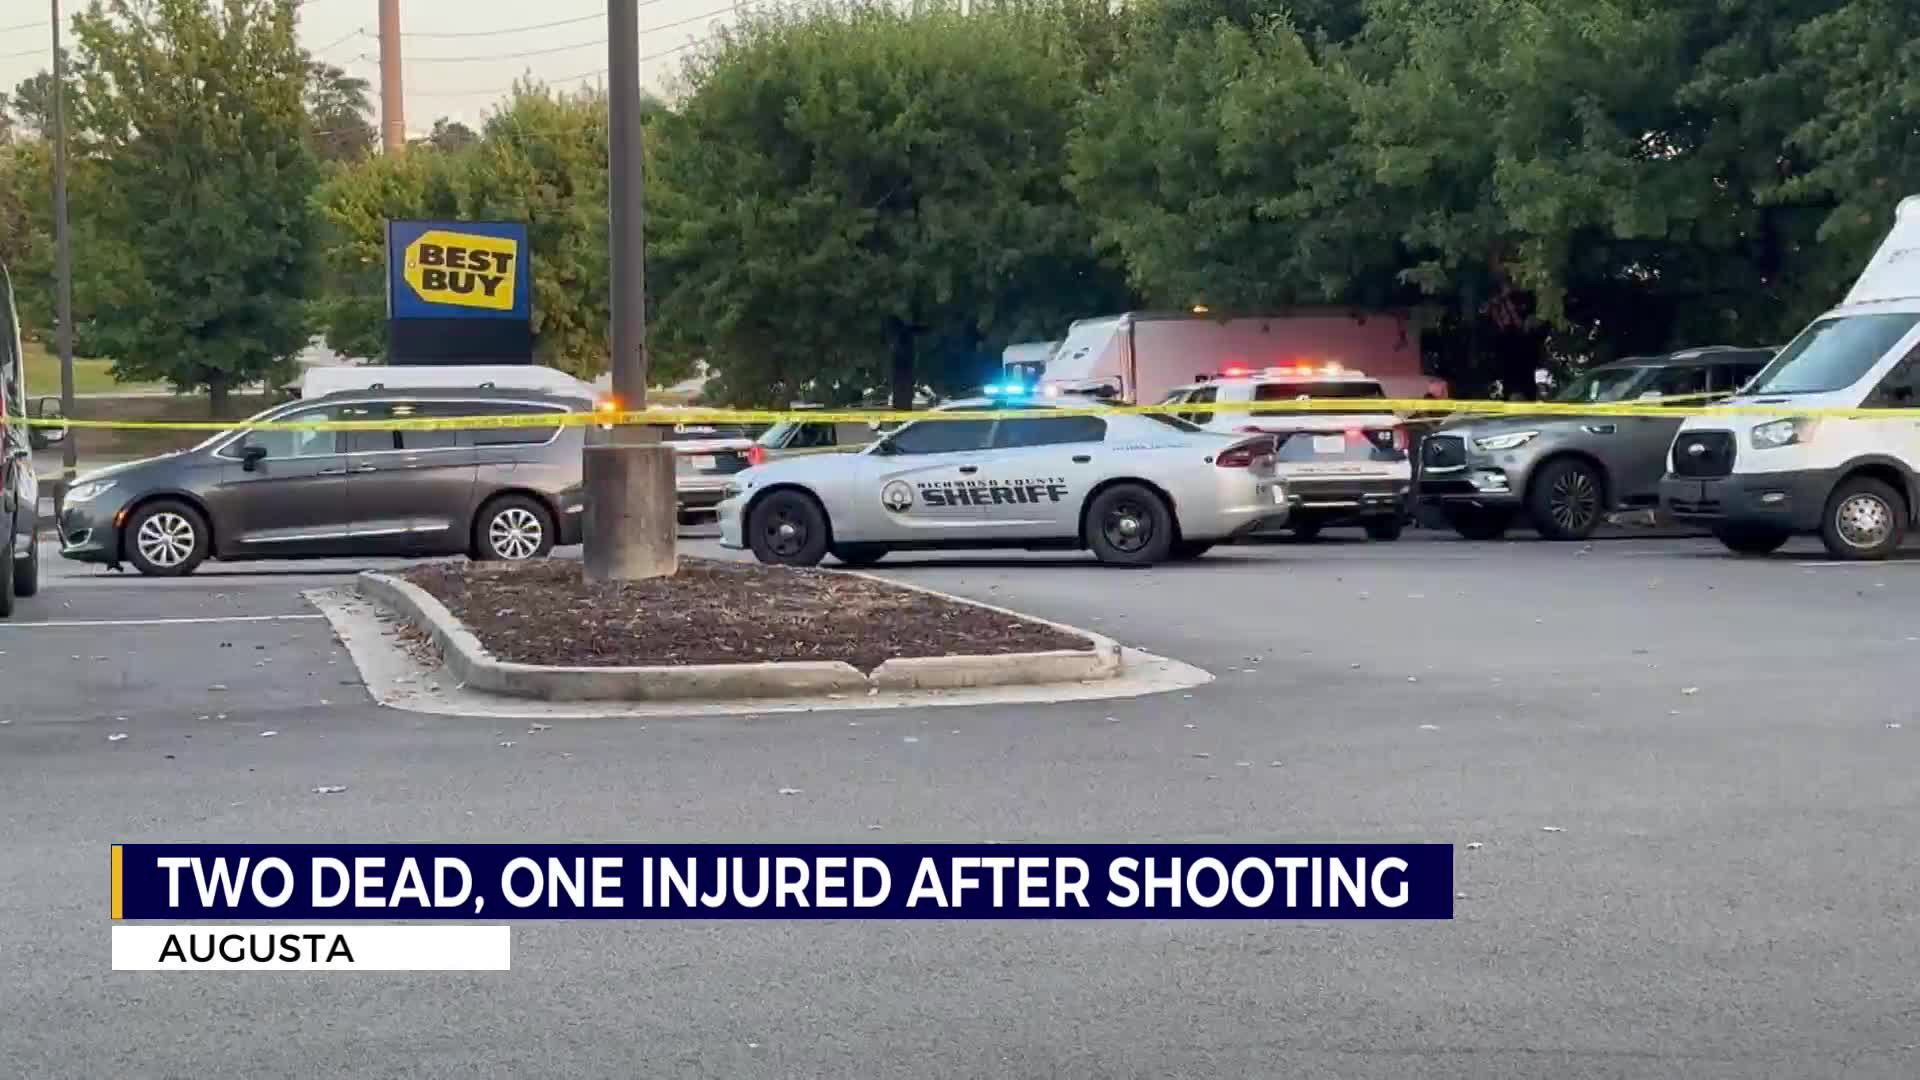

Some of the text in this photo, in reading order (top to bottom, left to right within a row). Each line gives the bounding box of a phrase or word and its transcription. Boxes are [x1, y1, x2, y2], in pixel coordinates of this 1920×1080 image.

[420, 244, 514, 273] BEST
[422, 269, 504, 296] BUY
[917, 477, 1066, 489] RICHMOND COUNTY
[921, 485, 1068, 506] SHERIFF
